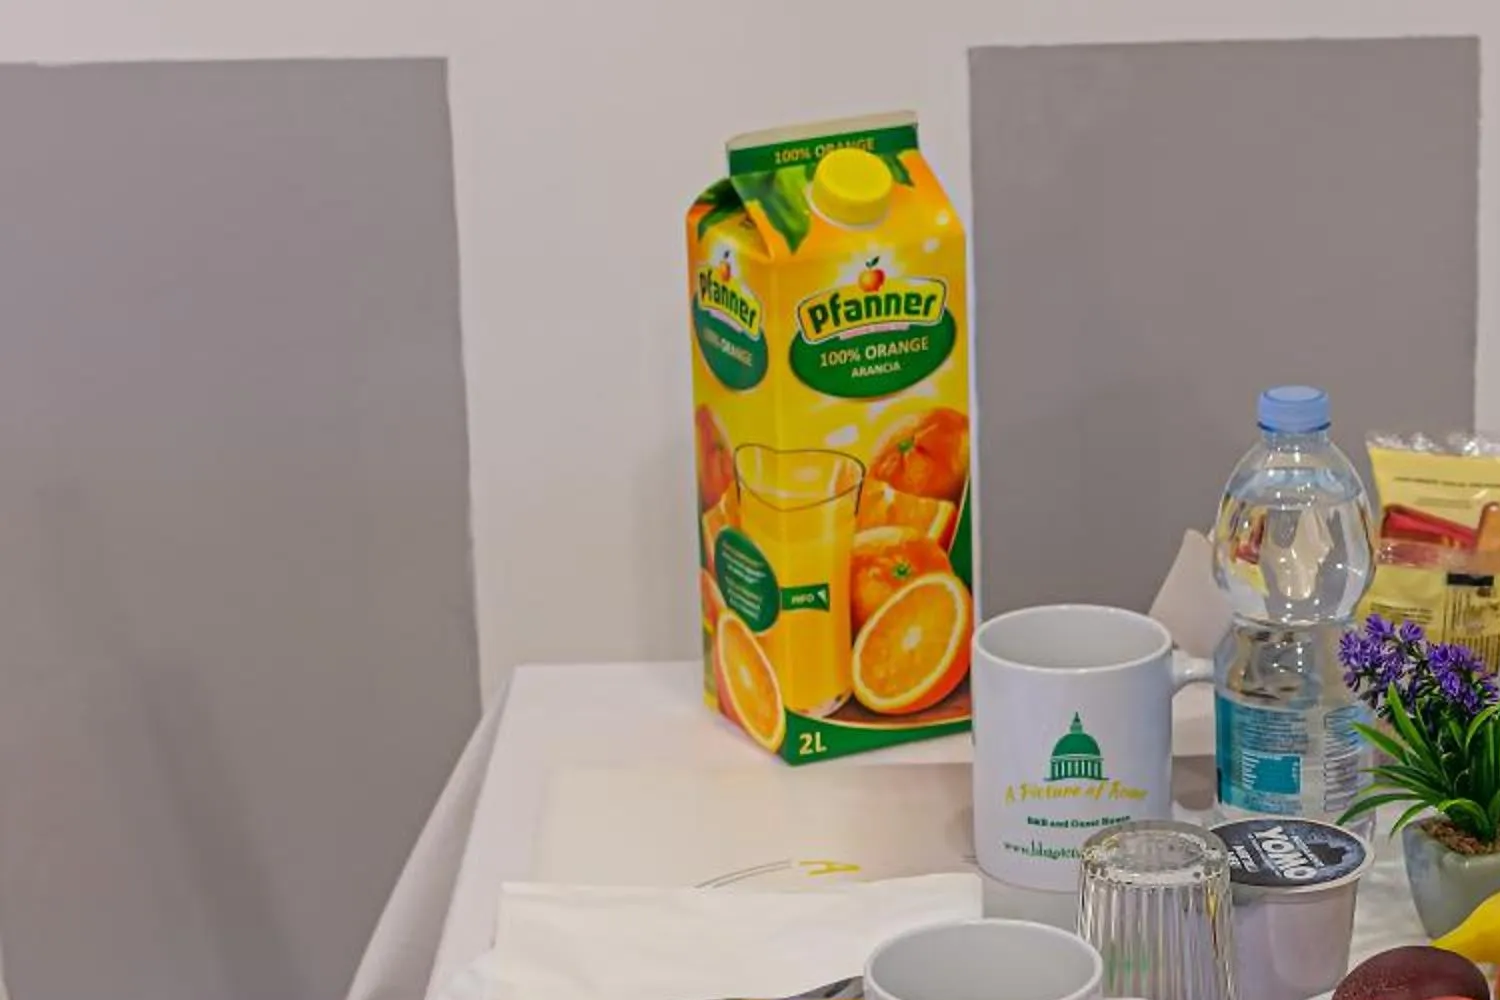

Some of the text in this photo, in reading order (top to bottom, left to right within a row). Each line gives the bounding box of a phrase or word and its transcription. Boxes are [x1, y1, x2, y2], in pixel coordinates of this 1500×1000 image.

[820, 336, 929, 367] 100% ORANGE
[851, 362, 901, 378] ARANCIA
[1252, 825, 1318, 879] YOMO
